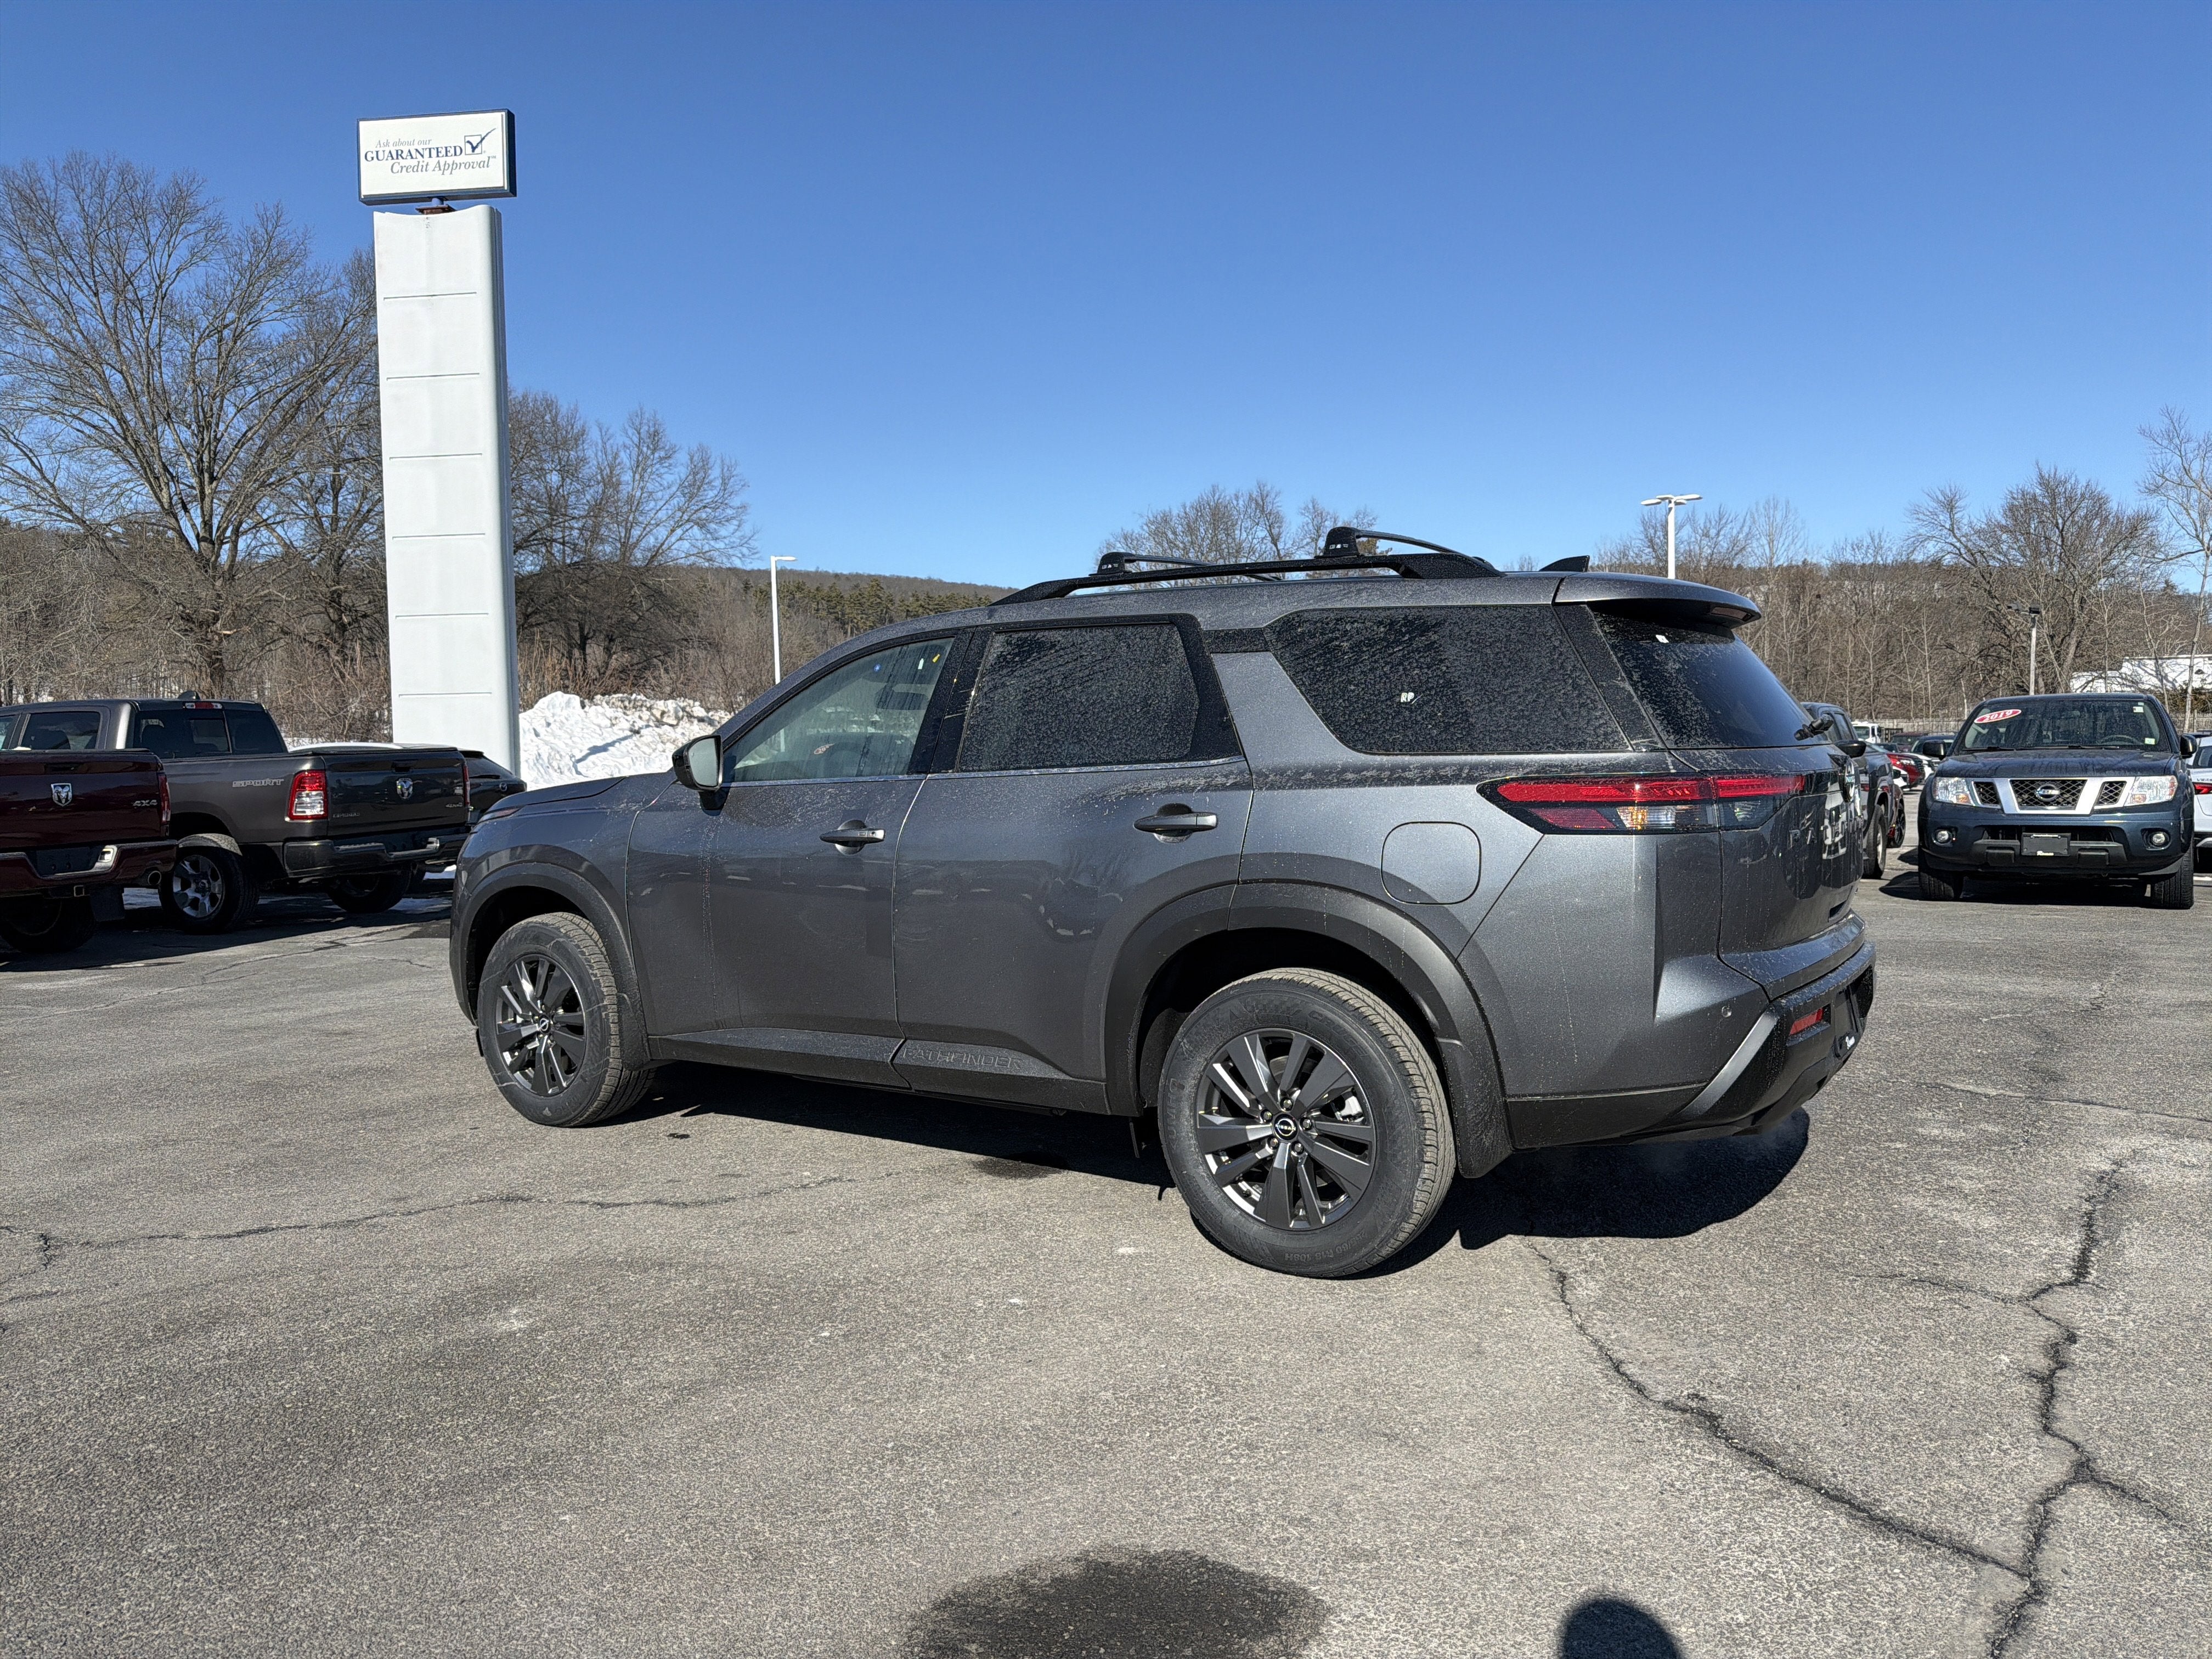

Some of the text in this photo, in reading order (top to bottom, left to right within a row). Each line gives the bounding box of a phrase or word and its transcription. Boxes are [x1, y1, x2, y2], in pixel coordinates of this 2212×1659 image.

[375, 139, 390, 149] Ask
[392, 138, 415, 147] about
[364, 145, 463, 162] GUARANTEED
[390, 160, 430, 174] Credit
[432, 156, 490, 176] Approval
[1985, 710, 2013, 721] 2019
[232, 778, 285, 788] SPORT
[902, 1047, 1024, 1070] PATHFINDER
